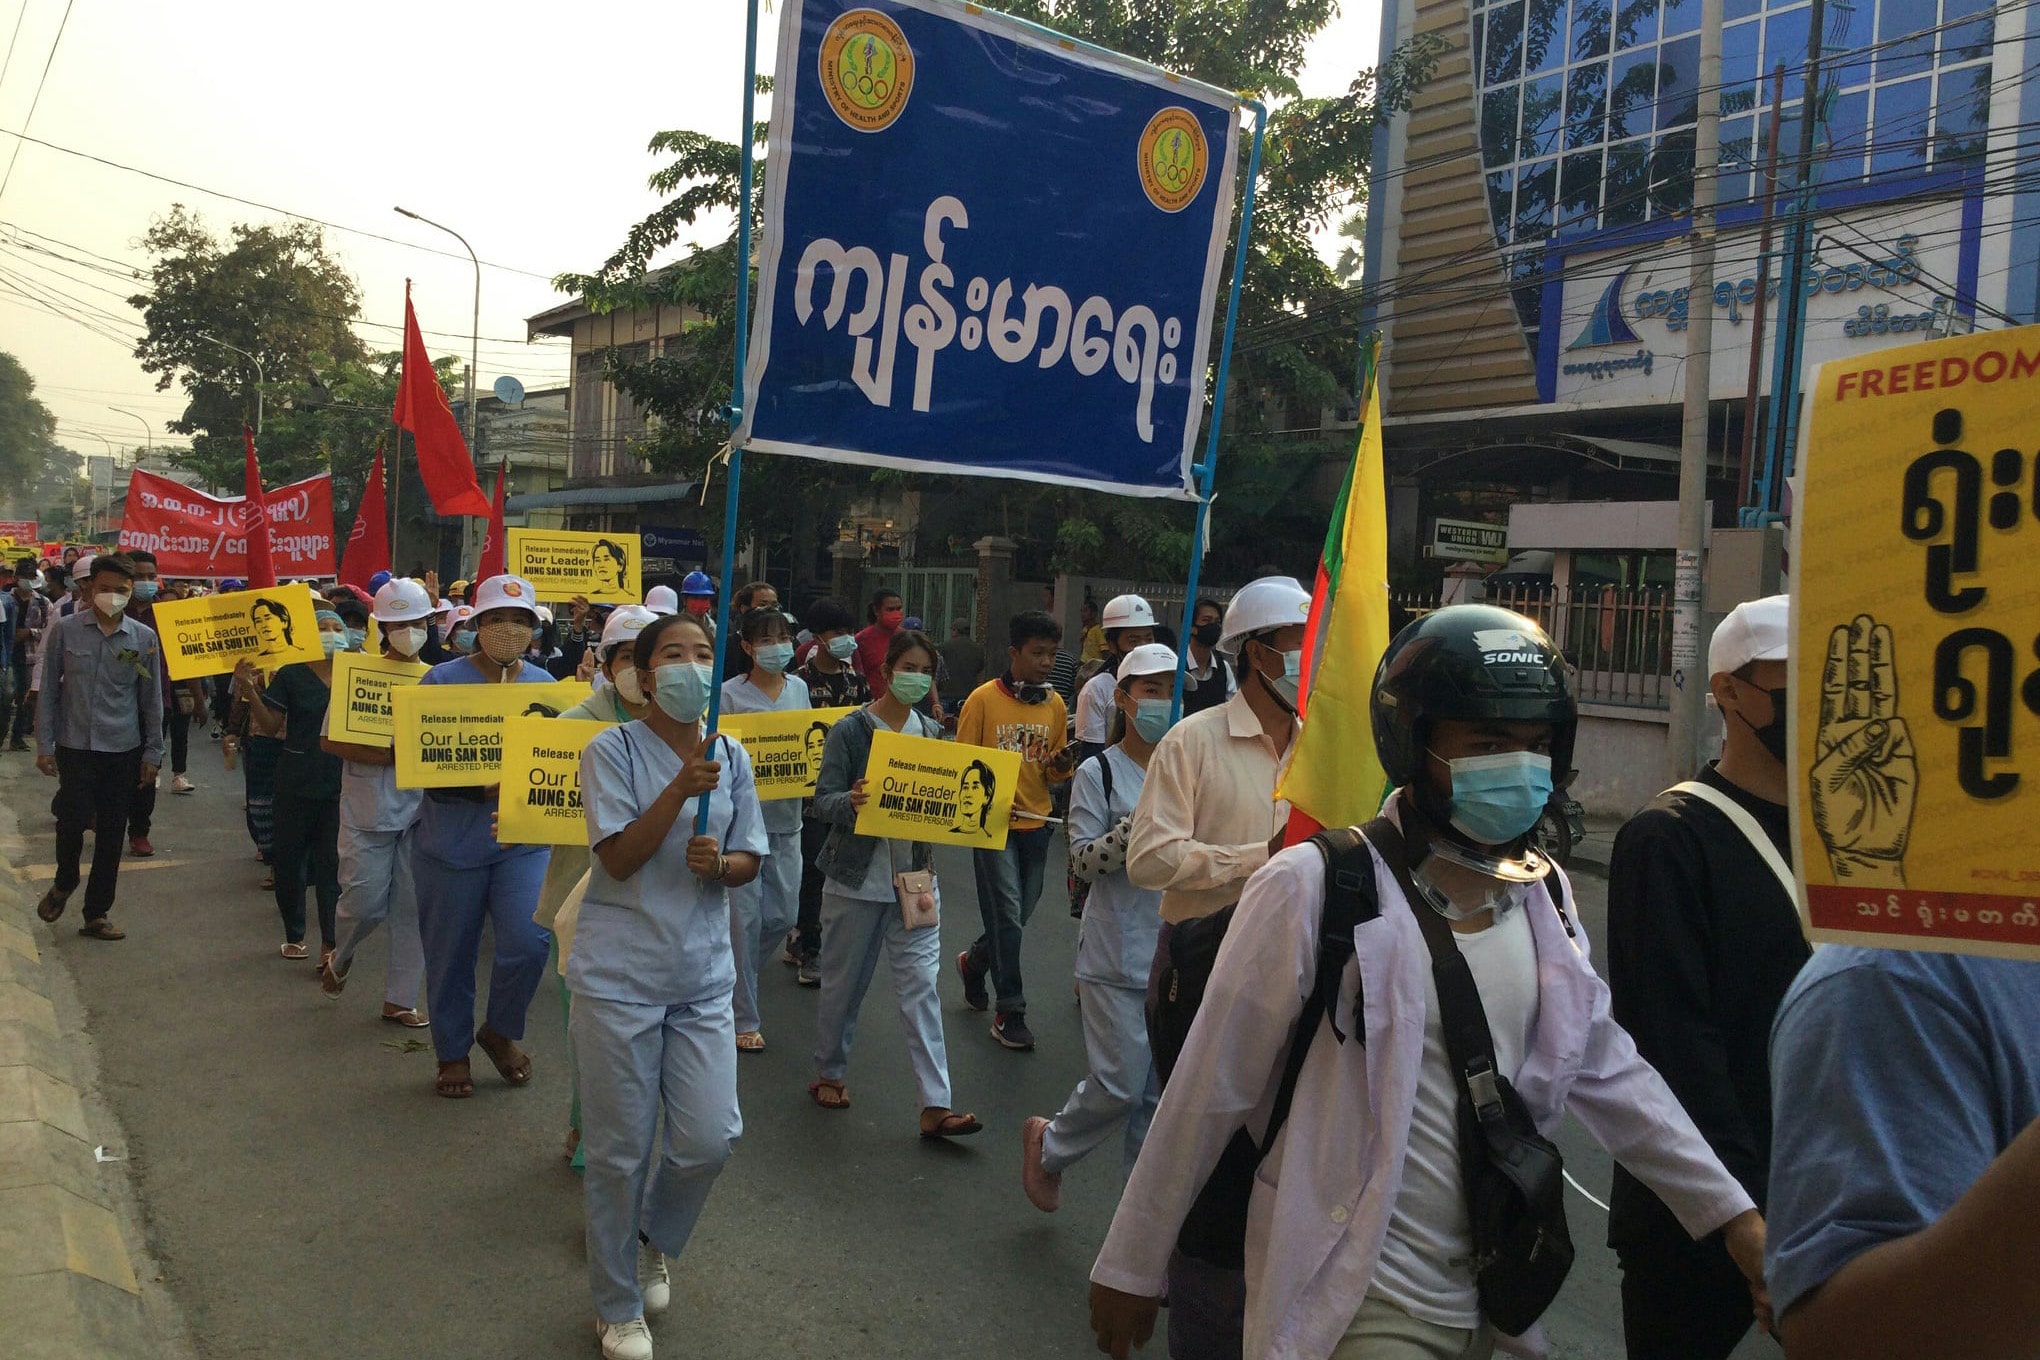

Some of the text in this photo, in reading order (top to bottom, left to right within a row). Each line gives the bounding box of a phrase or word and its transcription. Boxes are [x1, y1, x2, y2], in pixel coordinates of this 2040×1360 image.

[827, 60, 905, 123] MINISTRY OF HEALTH AND SPORTS
[793, 195, 1182, 443] ကျန်းမာရေး
[1440, 527, 1503, 546] WESTERN WU
[1451, 535, 1477, 544] UNION
[525, 545, 590, 556] Release Immediately
[525, 554, 591, 567] Our Leader
[523, 567, 593, 578] AUNG SAN SUU KYI
[174, 611, 246, 626] Release Immediately
[177, 625, 250, 644] Our Leader
[181, 635, 259, 656] AUNG SAN SUU KYI
[1484, 652, 1544, 664] SONIC
[355, 676, 387, 688] Release
[355, 687, 383, 701] Our
[351, 701, 393, 716] AUNG SA
[358, 715, 394, 726] ARRESTE
[421, 714, 457, 724] Release
[420, 732, 503, 747] Our Lead
[759, 734, 800, 743] Immediately
[421, 747, 502, 763] AUNG SAN SUU
[533, 747, 575, 760] Release
[757, 750, 802, 764] Leader
[436, 762, 481, 771] ARRESTED
[755, 763, 807, 778] SAN SUU KYI
[888, 758, 958, 779] Release Immediately
[529, 768, 567, 786] Our
[754, 775, 808, 786] ESTED PERSONS
[883, 776, 956, 800] Our Leader
[528, 788, 583, 807] AUNG SA
[544, 808, 585, 818] ARREST
[879, 794, 957, 818] AUNG SAN SUU KYI
[888, 811, 954, 827] ARRESTED PERSONS
